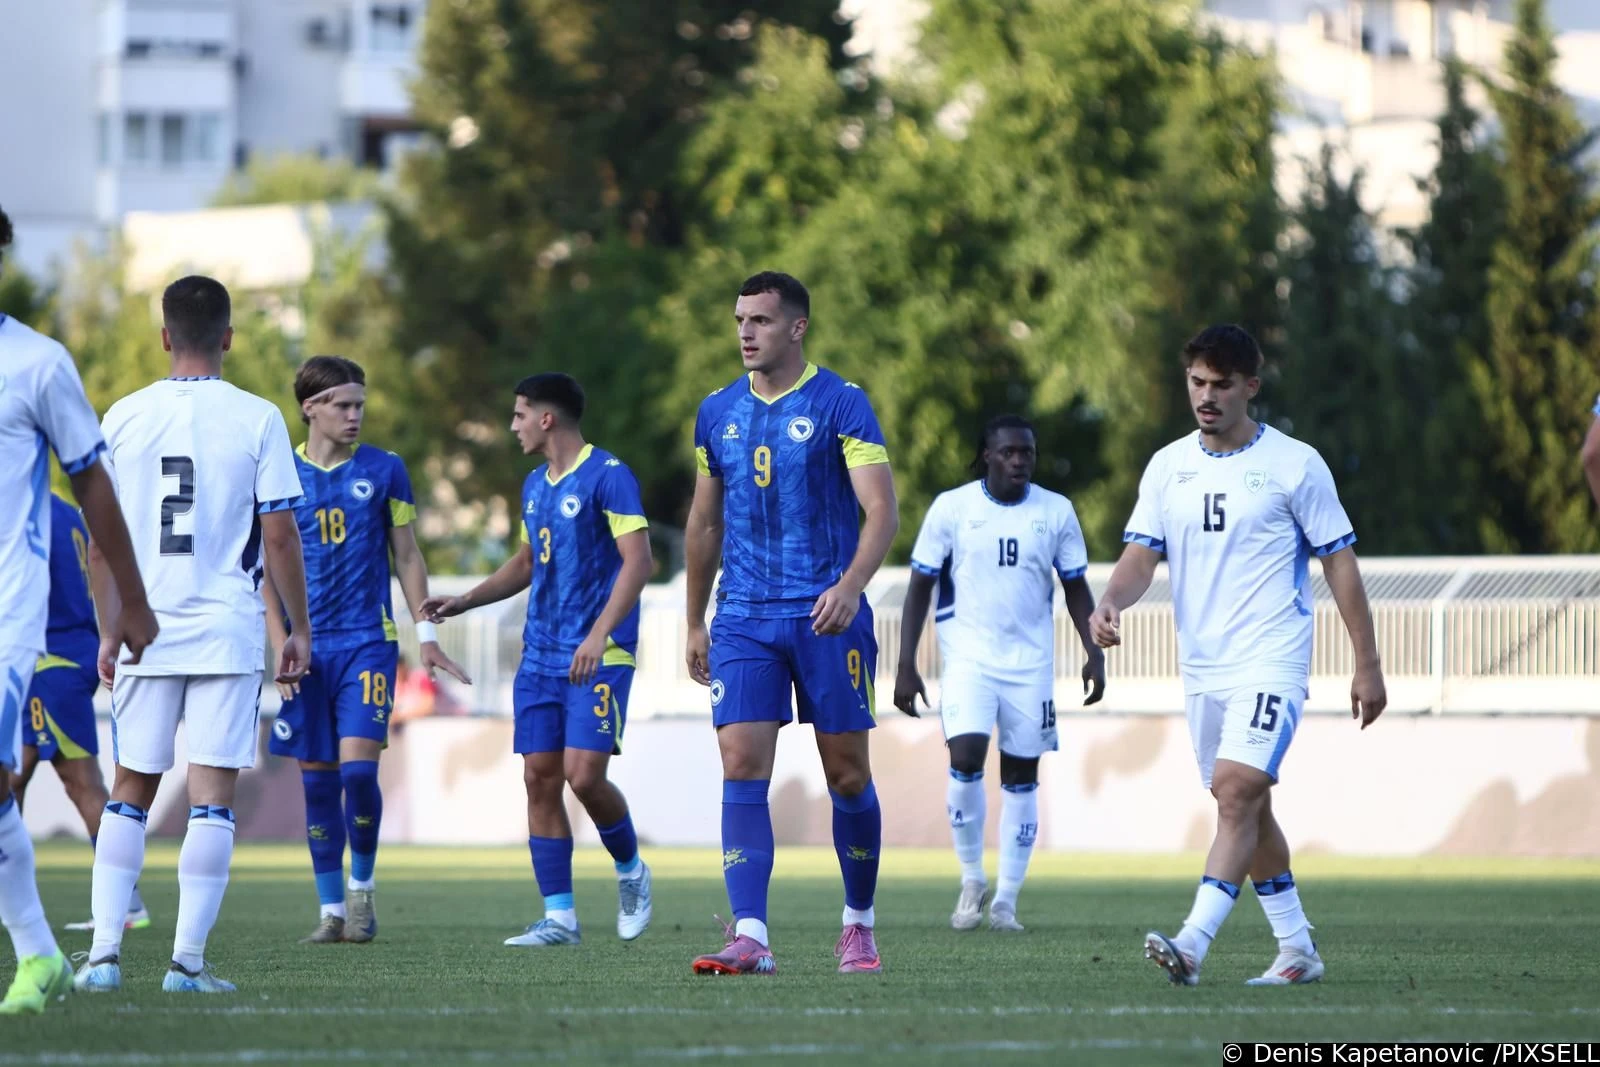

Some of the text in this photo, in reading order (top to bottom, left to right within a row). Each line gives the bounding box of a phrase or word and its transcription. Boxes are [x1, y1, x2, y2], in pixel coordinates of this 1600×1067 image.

[753, 446, 772, 487] 9
[160, 455, 195, 556] 2
[1203, 493, 1226, 533] 15
[315, 508, 347, 545] 18
[538, 527, 551, 565] 3
[997, 537, 1018, 568] 19
[847, 648, 861, 690] 9
[359, 670, 387, 707] 18
[593, 683, 611, 718] 3
[30, 696, 45, 732] 8
[1250, 692, 1282, 732] 15
